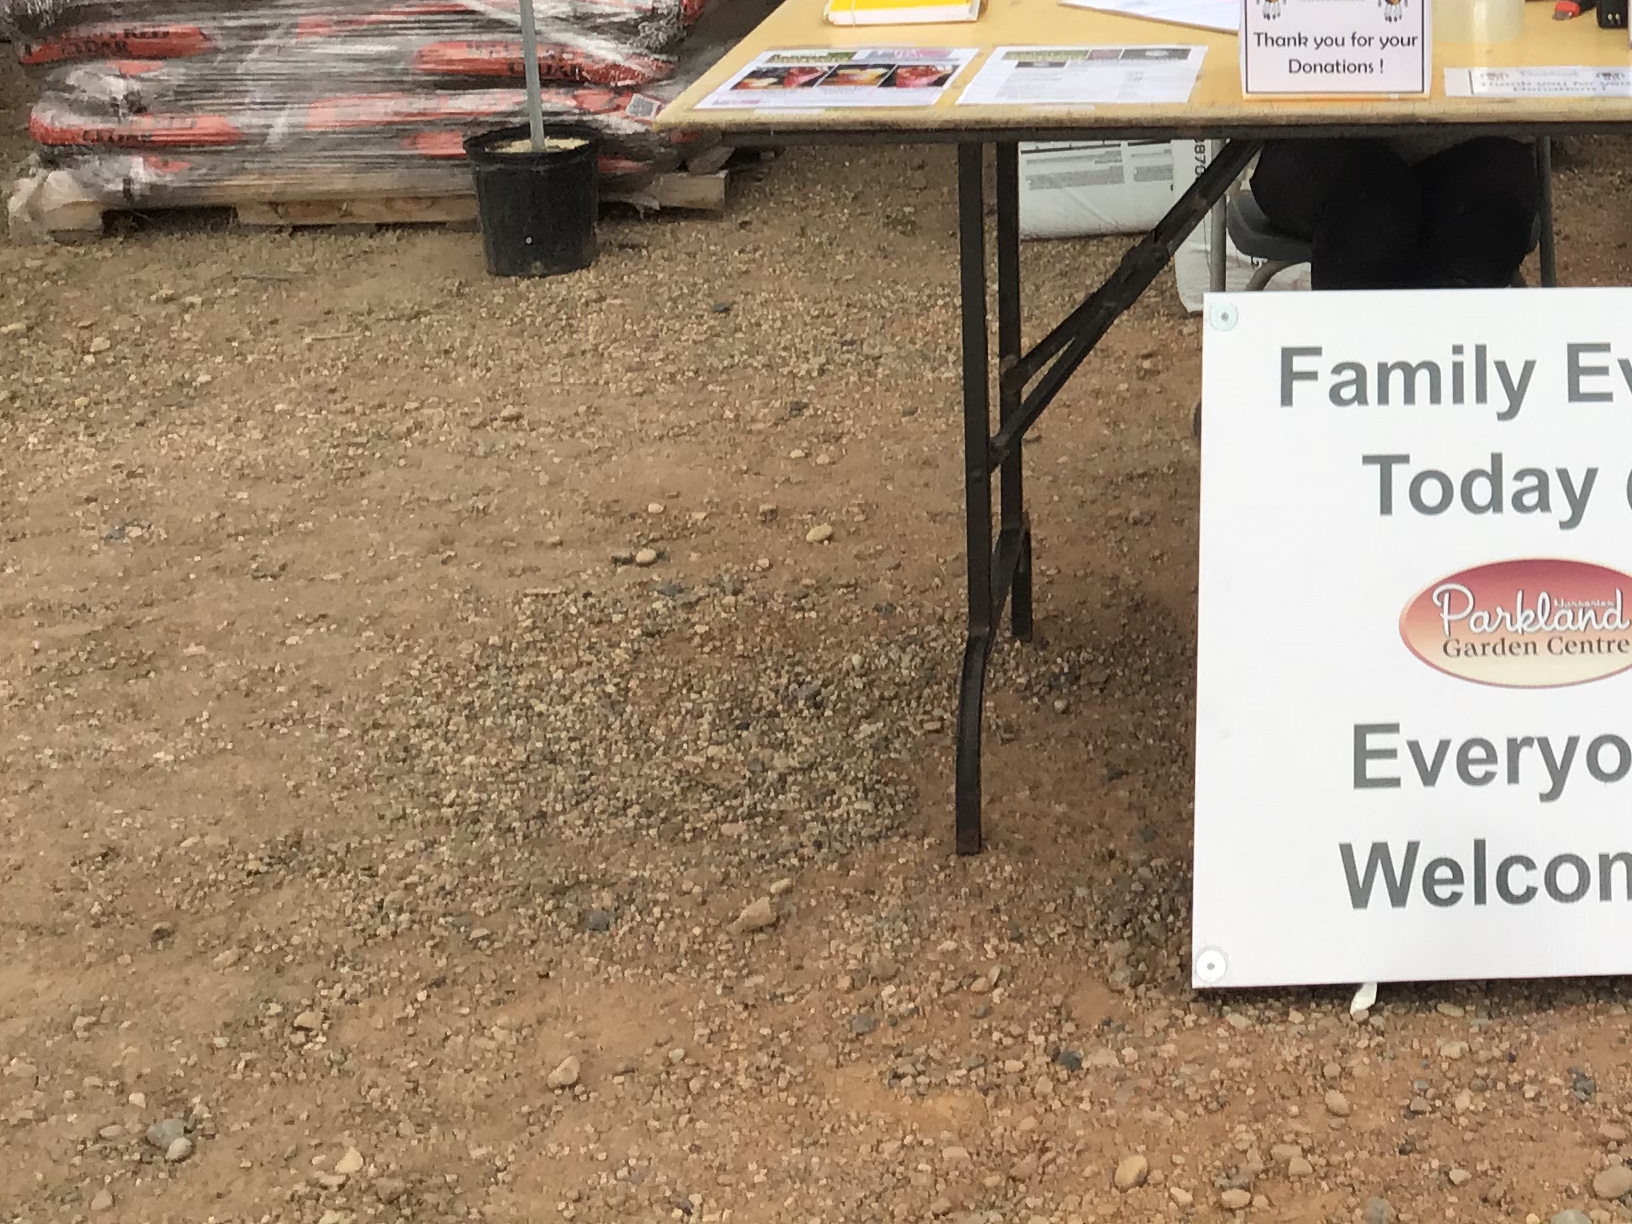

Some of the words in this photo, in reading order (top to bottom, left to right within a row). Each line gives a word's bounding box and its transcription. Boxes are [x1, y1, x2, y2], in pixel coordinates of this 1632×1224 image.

[1253, 32, 1308, 47] Thank
[1314, 35, 1345, 50] you
[1351, 32, 1375, 47] for
[1379, 35, 1419, 50] your
[1289, 58, 1374, 74] Donations
[1379, 58, 1384, 74] !
[1279, 343, 1536, 422] Family
[1362, 452, 1599, 530] Today
[1432, 583, 1631, 636] Parkland
[1442, 637, 1539, 658] Garden
[1547, 635, 1631, 656] Centre
